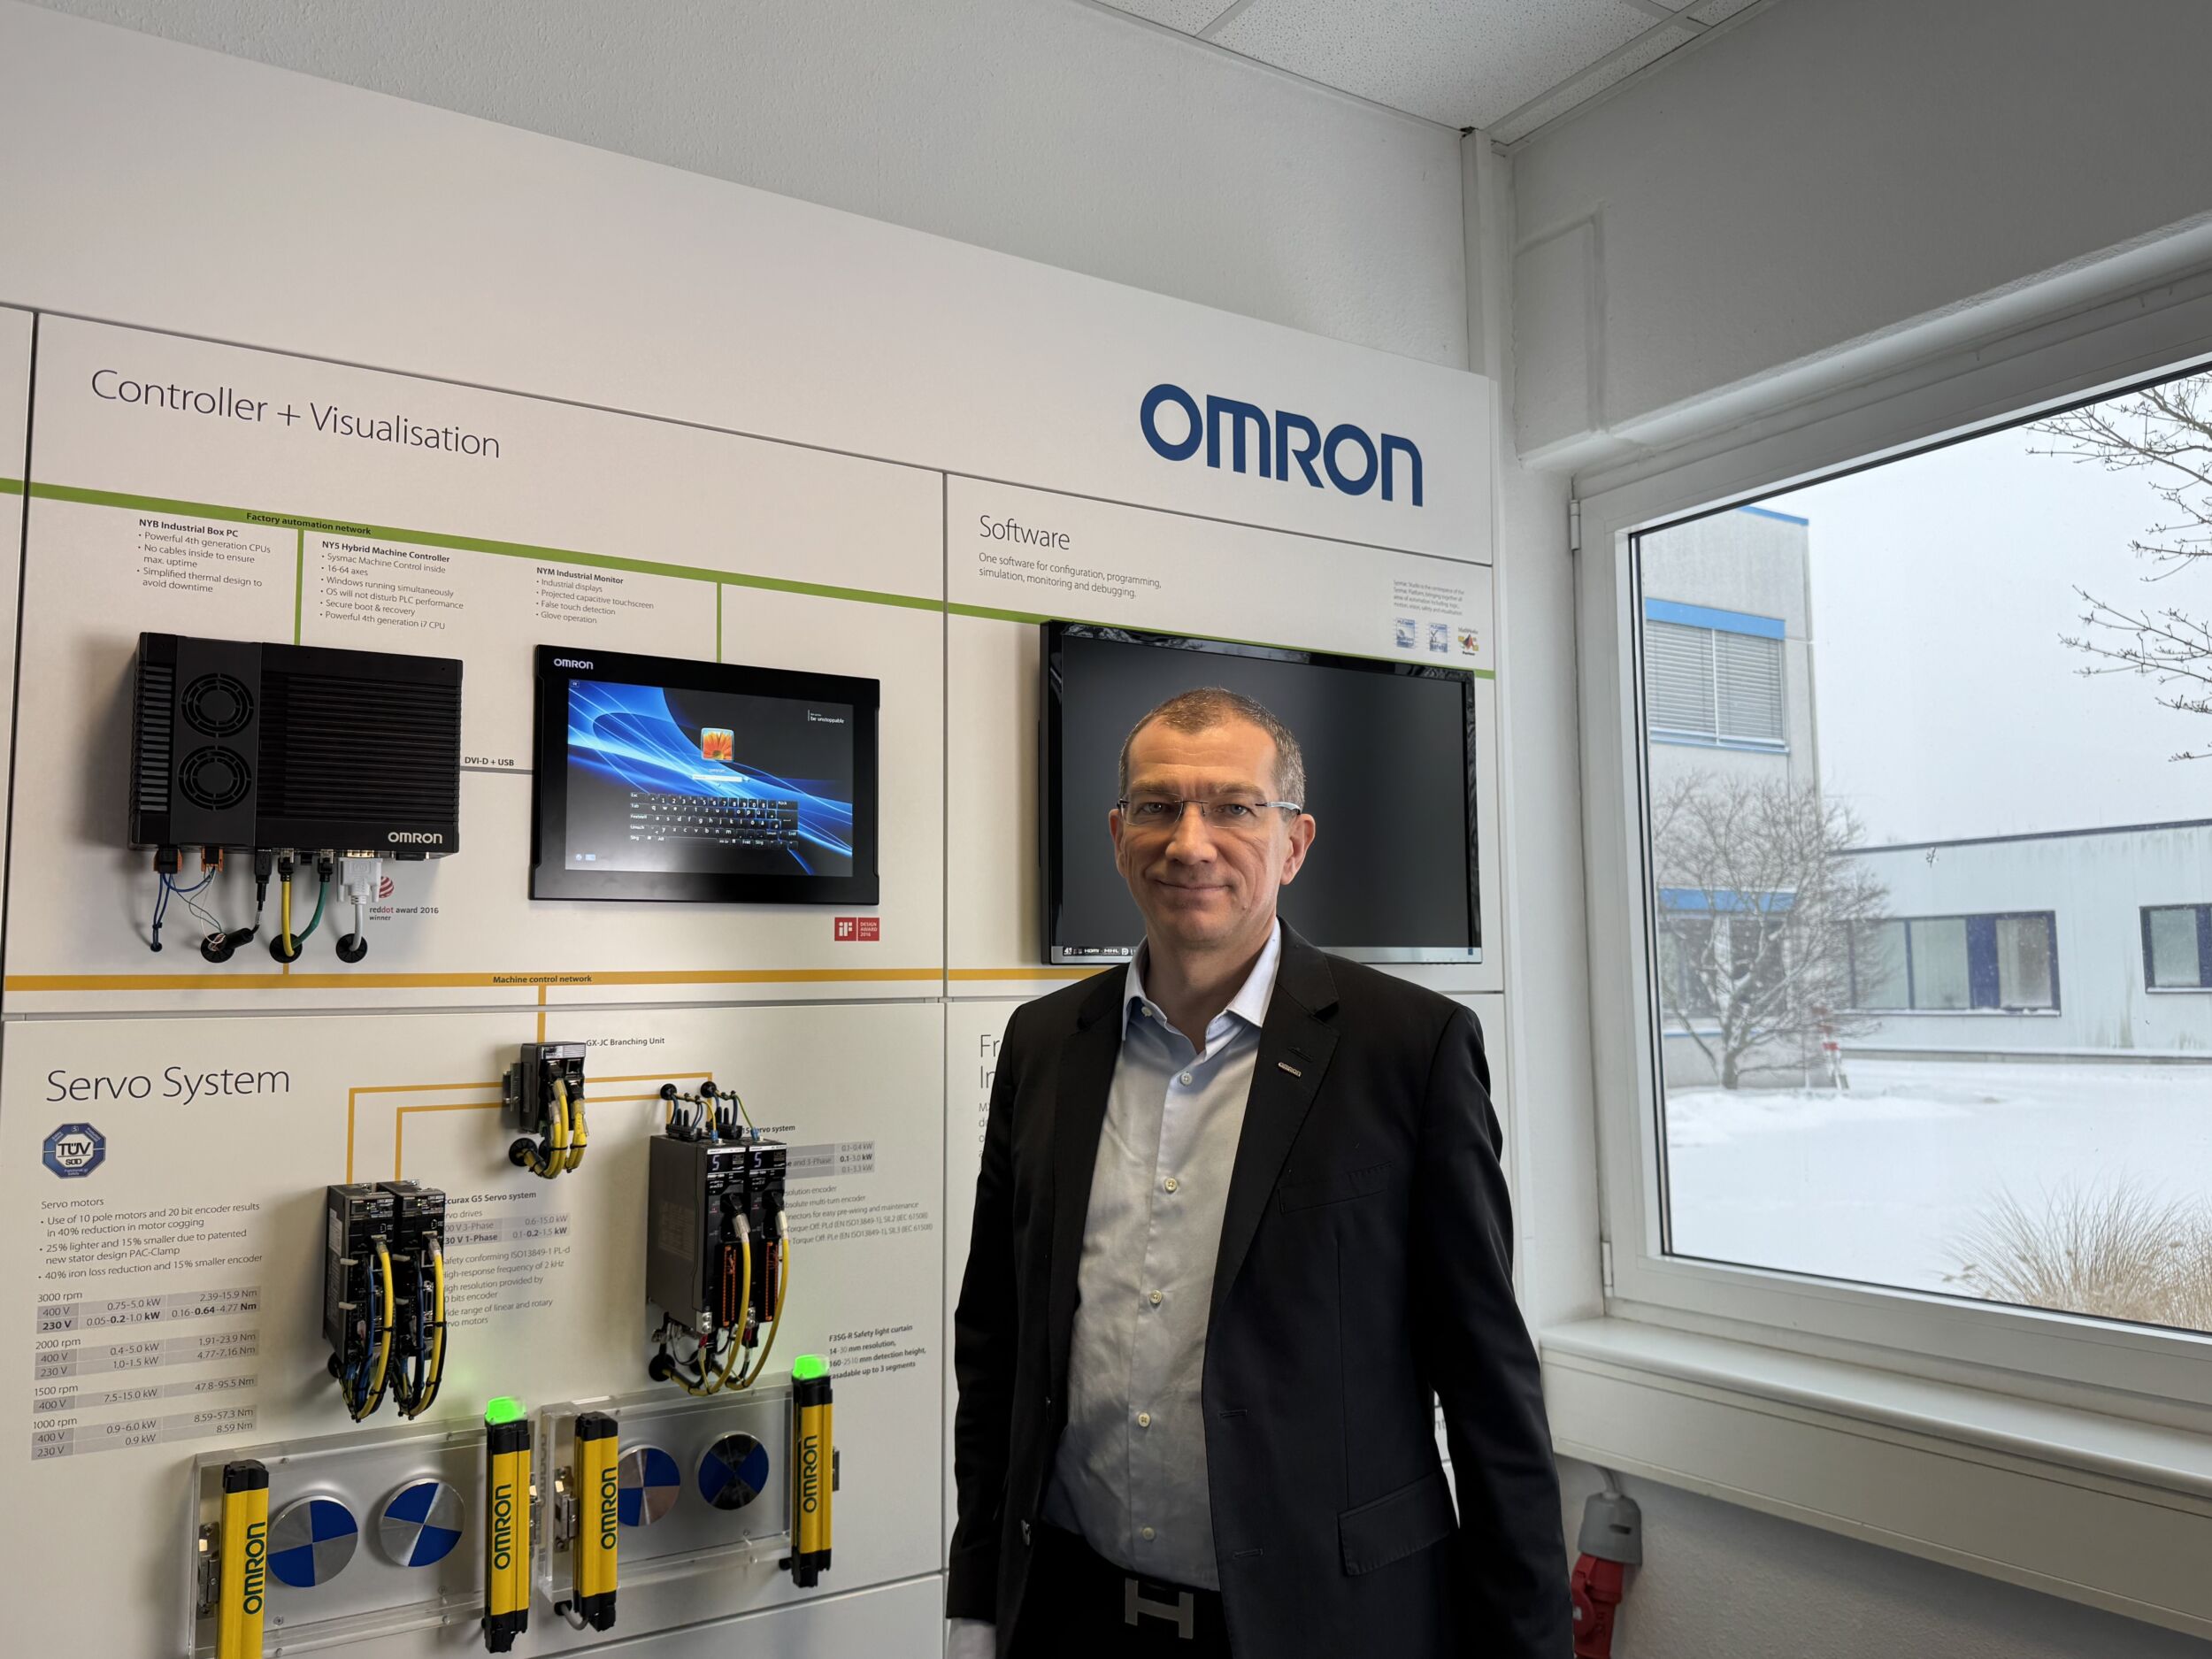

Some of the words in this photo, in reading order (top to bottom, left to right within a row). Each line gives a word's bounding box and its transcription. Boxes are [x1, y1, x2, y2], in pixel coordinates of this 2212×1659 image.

[92, 369, 268, 422] Controller
[276, 404, 301, 426] +
[310, 403, 500, 458] Visualisation
[1140, 383, 1423, 507] OMRON
[139, 518, 159, 528] NYB
[161, 521, 205, 533] Industrial
[207, 526, 224, 536] Box
[226, 529, 238, 537] PC
[246, 512, 280, 524] Factory
[282, 518, 333, 530] automation
[335, 525, 371, 535] network
[979, 514, 1071, 550] Software
[144, 531, 183, 543] Powerful
[184, 536, 199, 545] 4th
[201, 540, 247, 550] generation
[249, 543, 270, 553] CPUs
[322, 540, 339, 549] NY5
[341, 543, 370, 553] Hybrid
[372, 546, 407, 558] Machine
[409, 551, 450, 562] Controller
[143, 556, 164, 564] max.
[166, 558, 197, 568] uptime
[144, 543, 157, 552] No
[159, 546, 186, 556] cables
[188, 548, 214, 559] inside
[226, 554, 255, 563] ensure
[327, 552, 357, 563] Sysmac
[358, 556, 392, 567] Machine
[393, 560, 422, 571] Control
[423, 564, 445, 573] inside
[143, 566, 186, 579] Simplified
[188, 571, 221, 582] thermal
[223, 575, 251, 587] design
[328, 564, 349, 574] 16-64
[536, 566, 555, 575] NYM
[556, 569, 592, 580] Industrial
[593, 574, 623, 584] Monitor
[979, 552, 997, 564] One
[999, 556, 1035, 569] software
[1036, 560, 1048, 571] for
[1049, 564, 1105, 580] configuration,
[1106, 573, 1161, 589] programming,
[142, 579, 167, 588] avoid
[168, 581, 213, 592] downtime
[326, 576, 363, 587] Windows
[365, 581, 396, 592] running
[397, 584, 454, 598] simultaneously
[541, 578, 574, 589] Industrial
[574, 582, 602, 593] displays
[979, 566, 1025, 583] simulation,
[1026, 575, 1072, 591] monitoring
[1074, 581, 1089, 591] and
[1091, 583, 1136, 599] debugging.
[325, 599, 353, 609] Secure
[354, 601, 373, 611] boot
[374, 604, 381, 612] &
[382, 606, 415, 617] recovery
[326, 587, 338, 596] OS
[369, 592, 397, 602] disturb
[399, 595, 414, 604] PLC
[415, 598, 464, 609] performance
[541, 588, 575, 600] Projected
[576, 595, 611, 604] capacitive
[612, 598, 654, 609] touchscreen
[541, 599, 559, 609] False
[560, 603, 581, 611] touch
[582, 604, 615, 615] detection
[325, 610, 360, 621] Powerful
[376, 617, 419, 627] generation
[428, 621, 445, 630] CPU
[540, 610, 561, 620] Glove
[562, 615, 597, 623] operation
[554, 658, 594, 670] OMRON
[464, 756, 489, 765] DVI-D
[388, 831, 443, 844] OMRON
[586, 1039, 608, 1047] GX-JC
[610, 1038, 647, 1046] Branching
[46, 1070, 151, 1102] Servo
[163, 1066, 290, 1106] System
[58, 1142, 91, 1156] TÜV
[41, 1200, 68, 1210] Servo
[70, 1198, 104, 1207] motors
[47, 1216, 65, 1225] Use
[66, 1214, 77, 1223] of
[80, 1214, 90, 1223] 10
[92, 1212, 113, 1224] pole
[114, 1211, 147, 1220] motors
[149, 1208, 166, 1218] and
[168, 1208, 179, 1216] 20
[181, 1207, 193, 1215] bit
[194, 1204, 231, 1214] encoder
[232, 1202, 260, 1212] results
[47, 1229, 55, 1237] in
[57, 1227, 79, 1236] 40%
[81, 1224, 125, 1235] reduction
[138, 1222, 166, 1230] motor
[167, 1219, 204, 1229] cogging
[46, 1243, 68, 1253] 25%
[69, 1241, 99, 1252] lighter
[101, 1238, 119, 1248] and
[122, 1237, 142, 1246] 15%
[143, 1235, 175, 1245] smaller
[176, 1233, 194, 1242] due
[207, 1228, 247, 1241] patented
[68, 1254, 94, 1263] stator
[96, 1251, 127, 1261] design
[129, 1247, 180, 1258] PAC-Clamp
[44, 1270, 66, 1280] 40%
[68, 1270, 86, 1278] iron
[88, 1267, 106, 1276] loss
[108, 1264, 152, 1274] reduction
[153, 1261, 171, 1271] and
[174, 1259, 193, 1269] 15%
[195, 1257, 226, 1267] smaller
[227, 1254, 262, 1264] encoder
[875, 1328, 889, 1336] light
[803, 1435, 818, 1513] OMRON
[601, 1467, 617, 1550] OMRON
[494, 1484, 511, 1568] OMRON
[243, 1522, 265, 1614] OMRON
